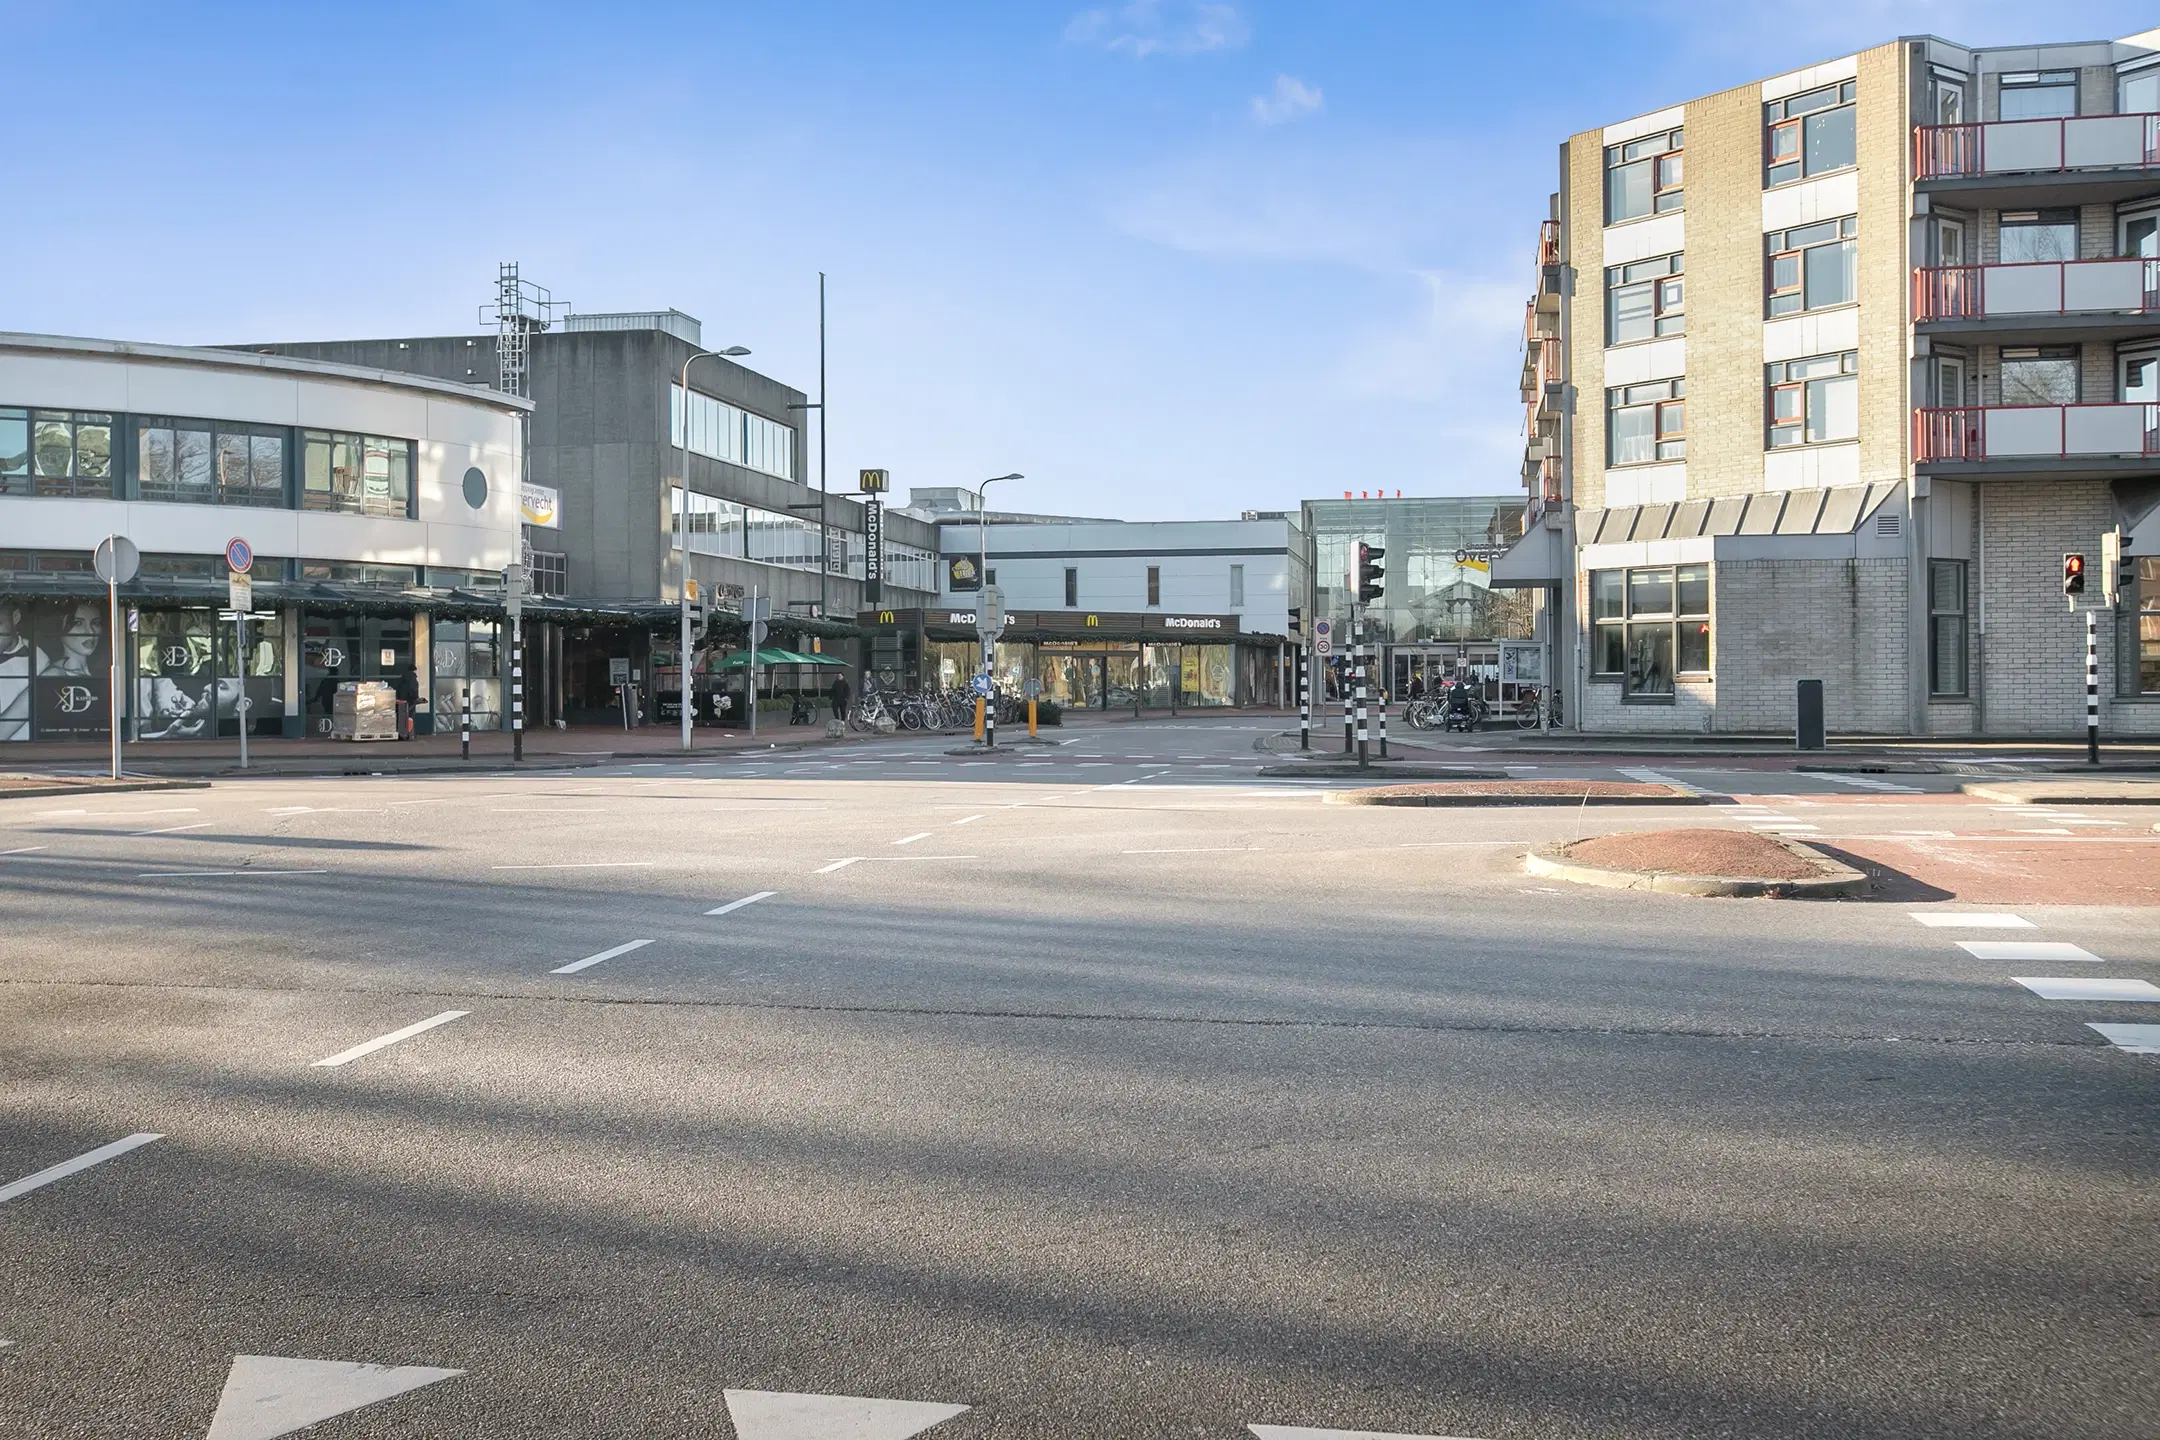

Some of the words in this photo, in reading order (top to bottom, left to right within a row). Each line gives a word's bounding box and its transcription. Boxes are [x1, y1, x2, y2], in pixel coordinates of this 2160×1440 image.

[521, 495, 553, 511] ervecht
[868, 503, 878, 580] McDonald's
[950, 613, 1016, 625] McD's
[1165, 617, 1221, 628] McDonald's
